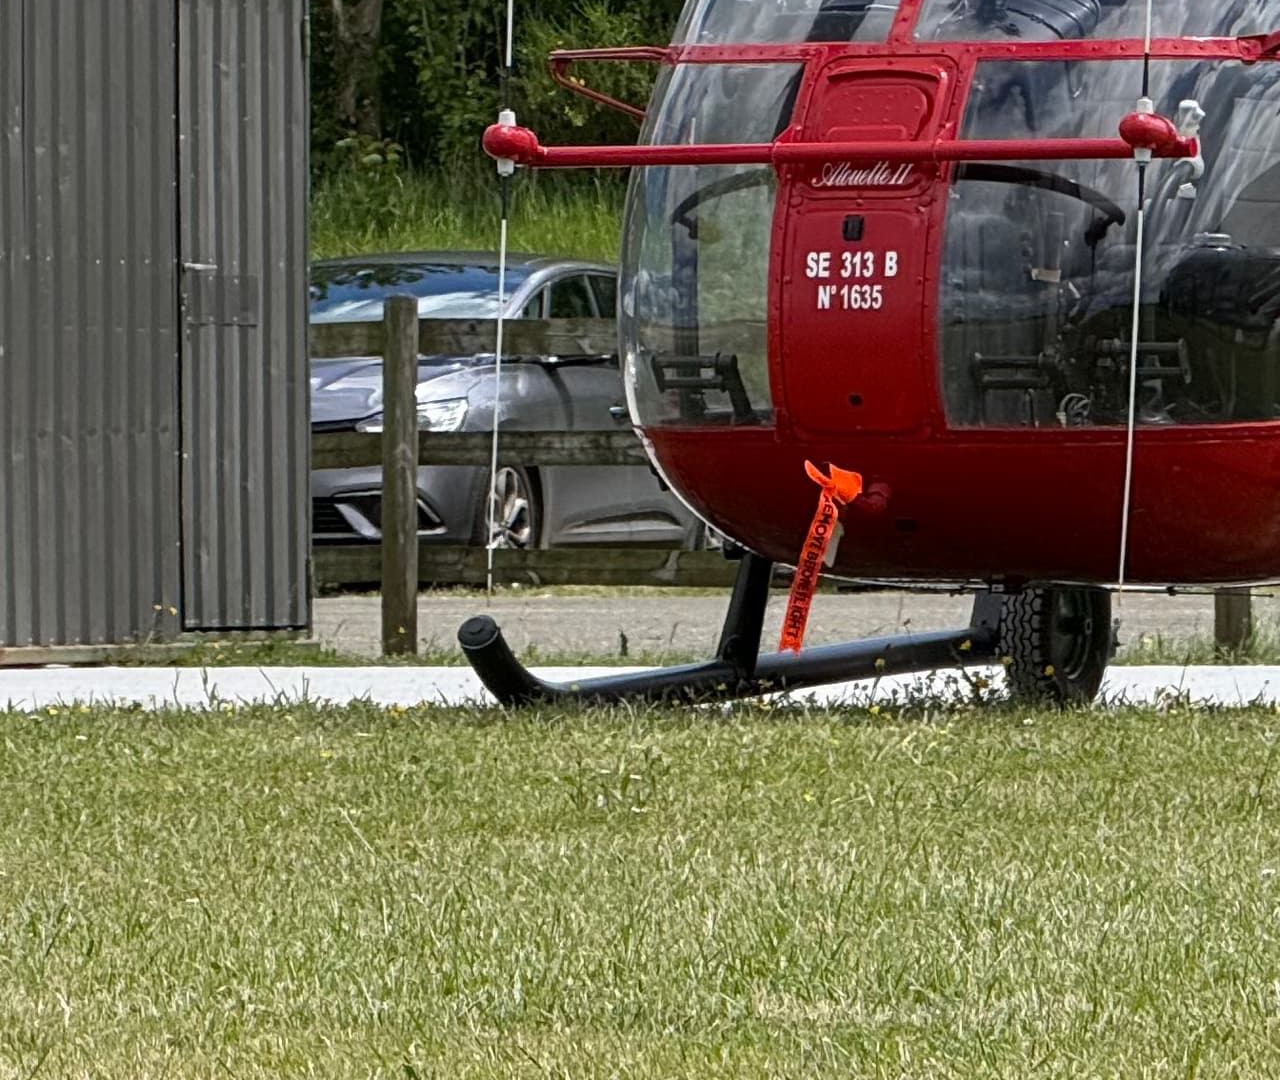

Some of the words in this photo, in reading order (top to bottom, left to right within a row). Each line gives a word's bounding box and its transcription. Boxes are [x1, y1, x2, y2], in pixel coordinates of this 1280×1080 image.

[811, 161, 891, 188] Alouette
[805, 251, 831, 278] SE
[840, 251, 874, 278] 313
[884, 251, 898, 277] B
[840, 284, 883, 310] 1635
